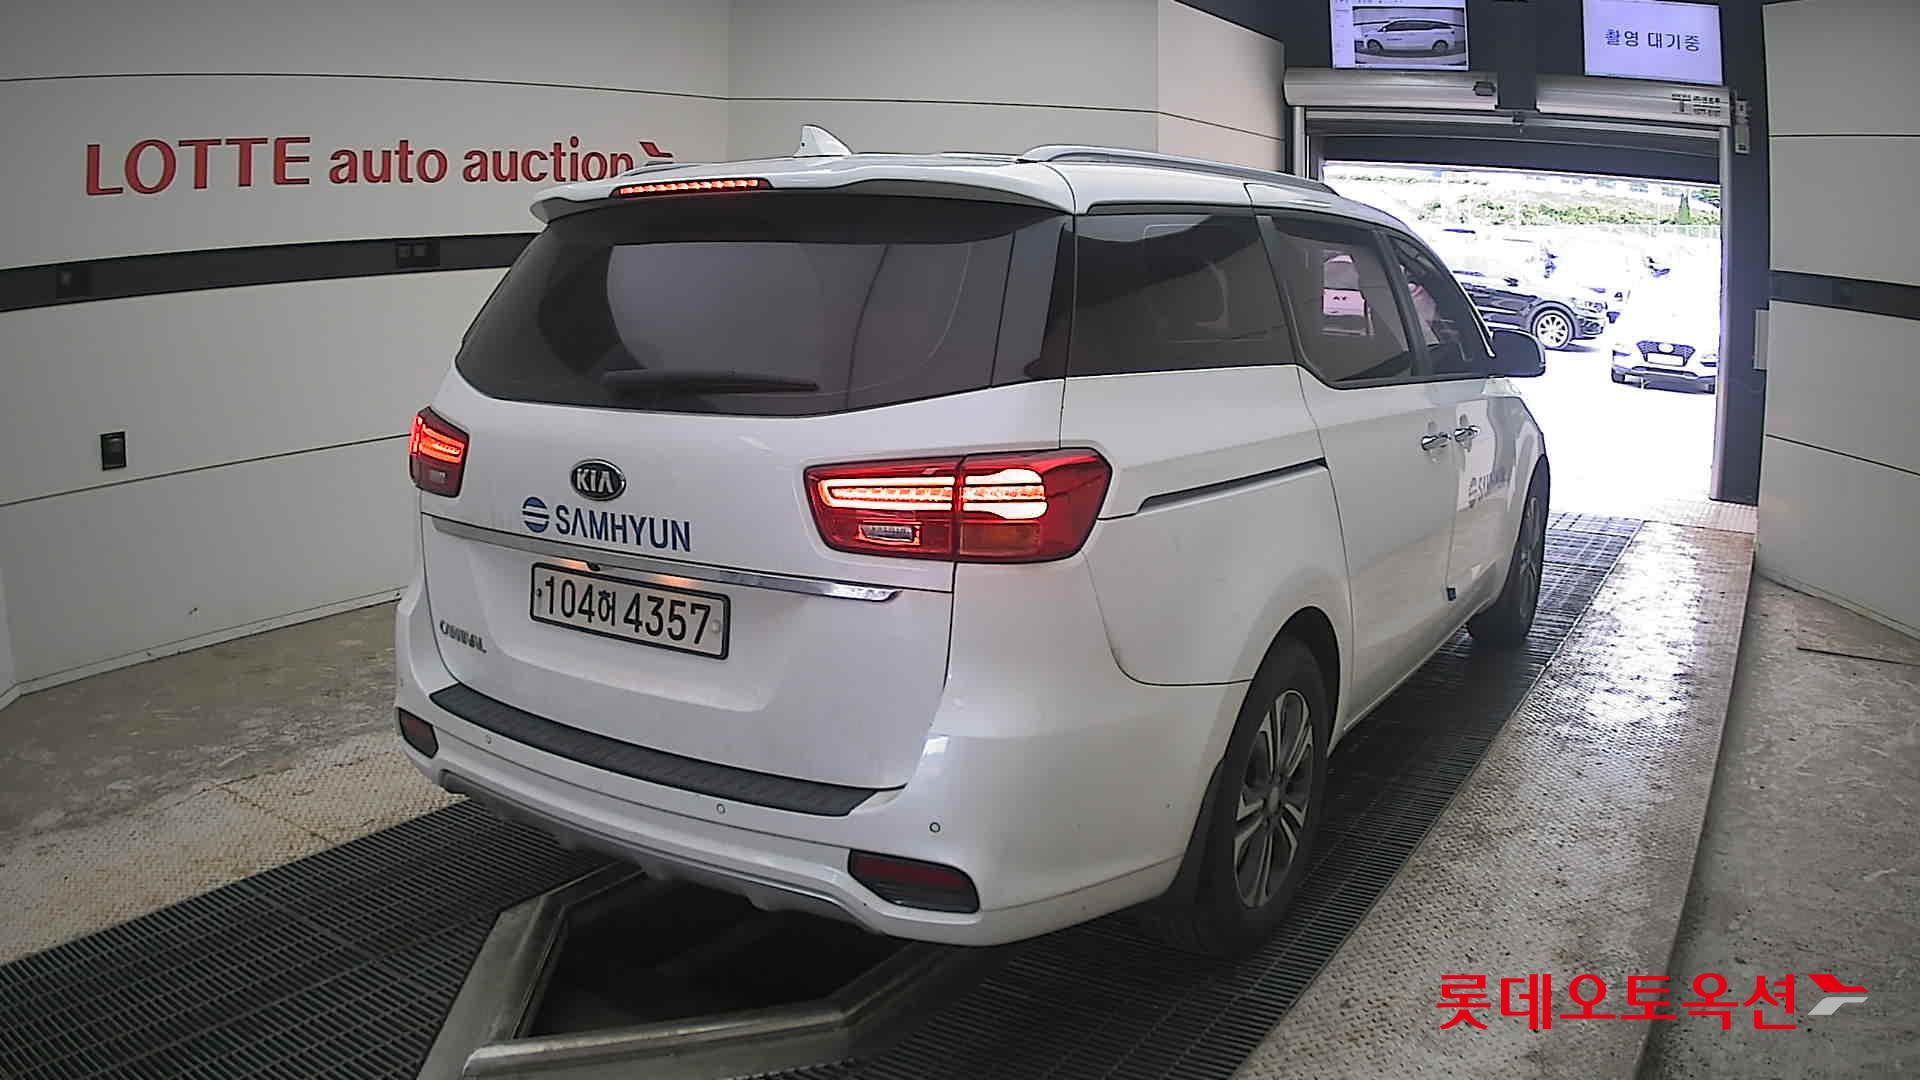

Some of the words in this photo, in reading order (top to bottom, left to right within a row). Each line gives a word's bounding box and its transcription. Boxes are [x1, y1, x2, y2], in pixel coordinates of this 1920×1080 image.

[1648, 32, 1700, 51] 대기중
[86, 136, 311, 196] LOTTE
[329, 139, 448, 184] auto
[462, 136, 634, 183] auction
[576, 468, 614, 493] KIA
[555, 504, 691, 552] SAMHYUN
[623, 592, 711, 645] 4357
